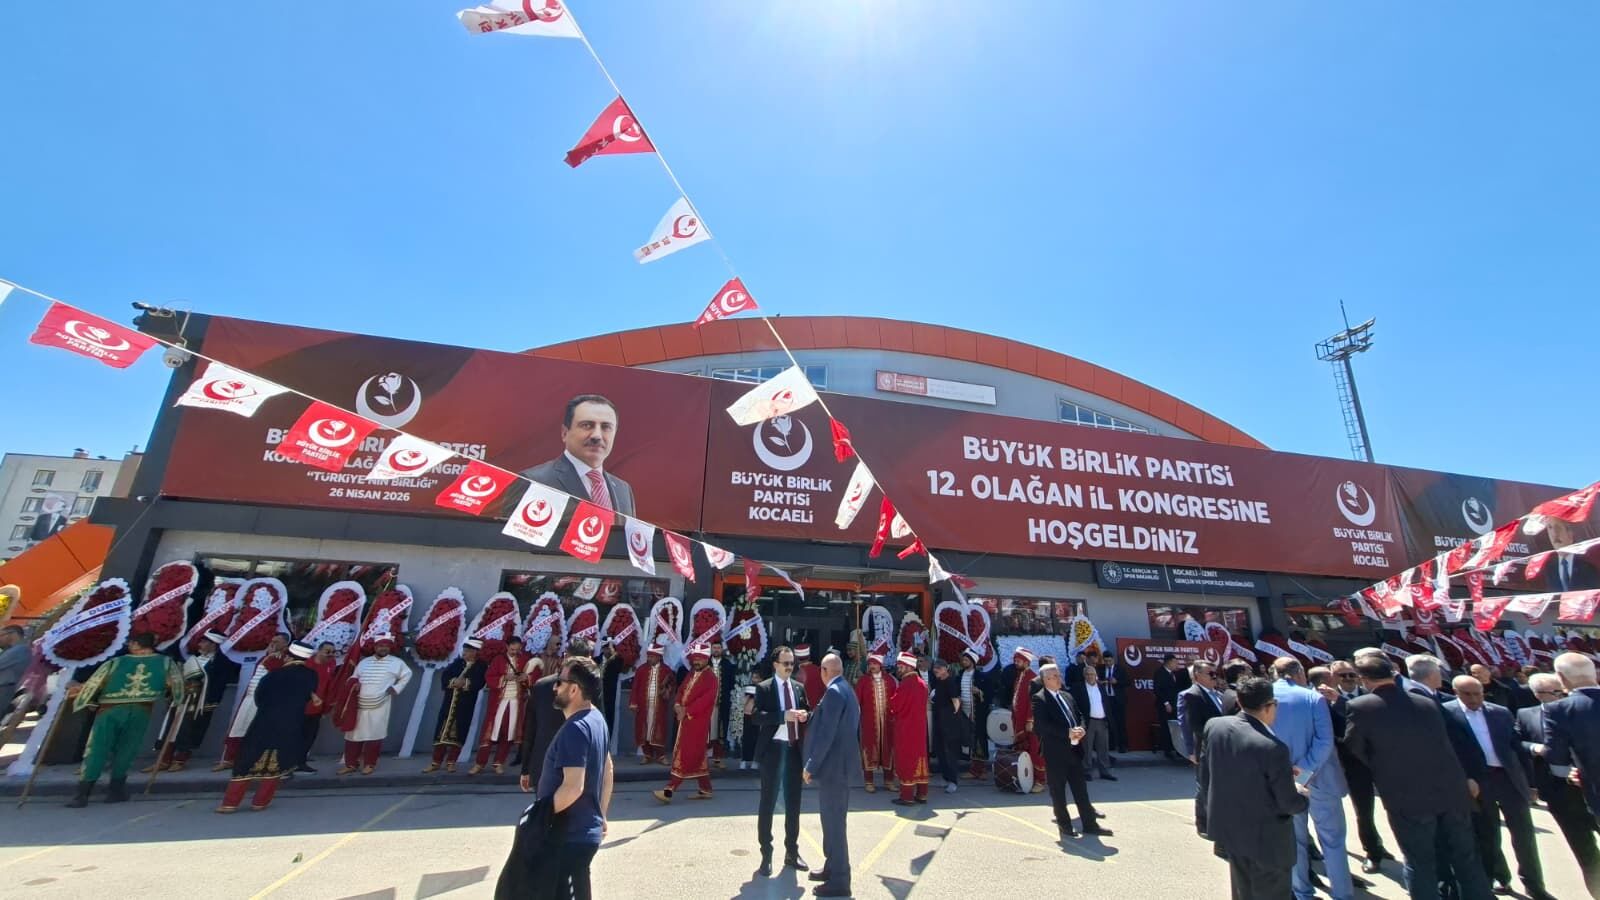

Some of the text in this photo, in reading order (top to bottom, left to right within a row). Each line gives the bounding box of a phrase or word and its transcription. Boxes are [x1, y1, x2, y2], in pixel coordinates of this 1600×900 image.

[962, 436, 1235, 487] BÜYÜK BİRLİK PARTİSİ
[731, 471, 832, 492] BÜYÜK BİRLİK
[329, 487, 410, 502] 26 NİSAN 2026
[753, 489, 810, 506] PARTİSİ
[926, 469, 1271, 524] 12. OLAĞAN İL KONGRESİNE
[749, 506, 813, 523] KOCAELİ
[1028, 518, 1199, 554] HOŞGELDİNİZ
[1333, 528, 1394, 543] BÜYÜK BİRLİK
[1351, 542, 1384, 554] PARTİSİ
[1503, 543, 1530, 554] ARTİSİ
[1353, 554, 1389, 568] KOCAELİ
[1172, 568, 1198, 577] KOCAELİ
